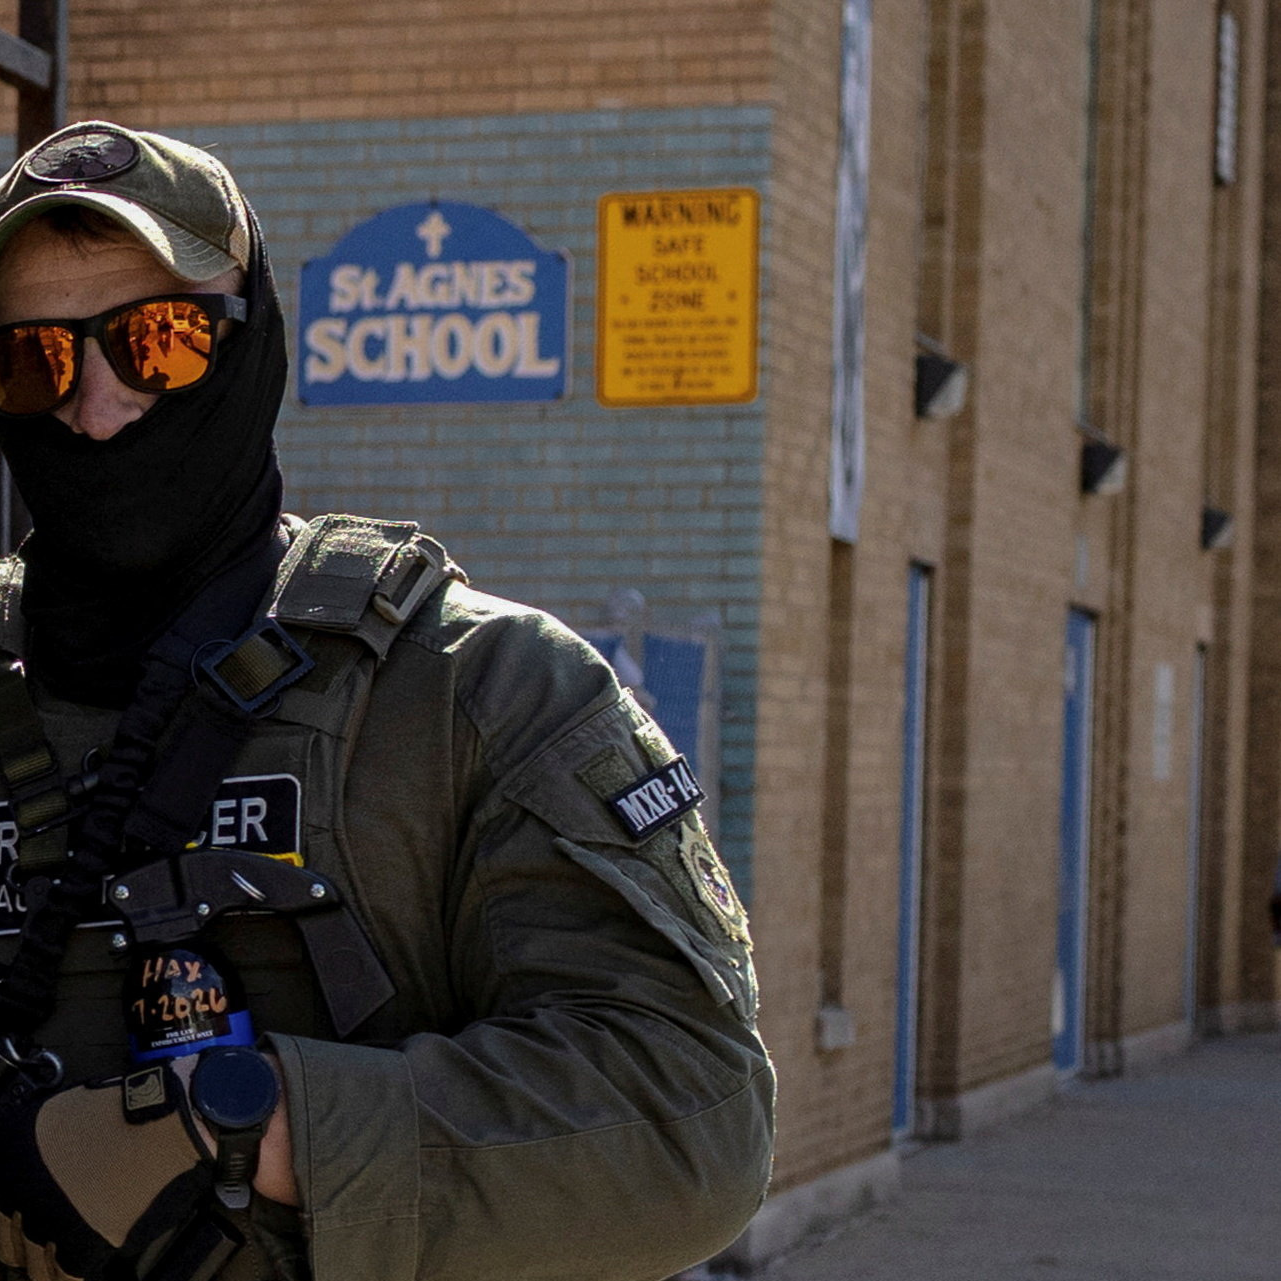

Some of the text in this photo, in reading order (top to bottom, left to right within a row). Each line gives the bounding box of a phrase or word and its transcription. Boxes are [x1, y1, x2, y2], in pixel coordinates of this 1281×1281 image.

[622, 197, 741, 227] WARNING
[653, 234, 705, 256] SAFE
[390, 260, 537, 311] AGNES
[636, 263, 718, 286] SCHOOL
[649, 287, 705, 312] ZONE
[304, 313, 561, 384] SCHOOL
[618, 762, 699, 832] MXR-14
